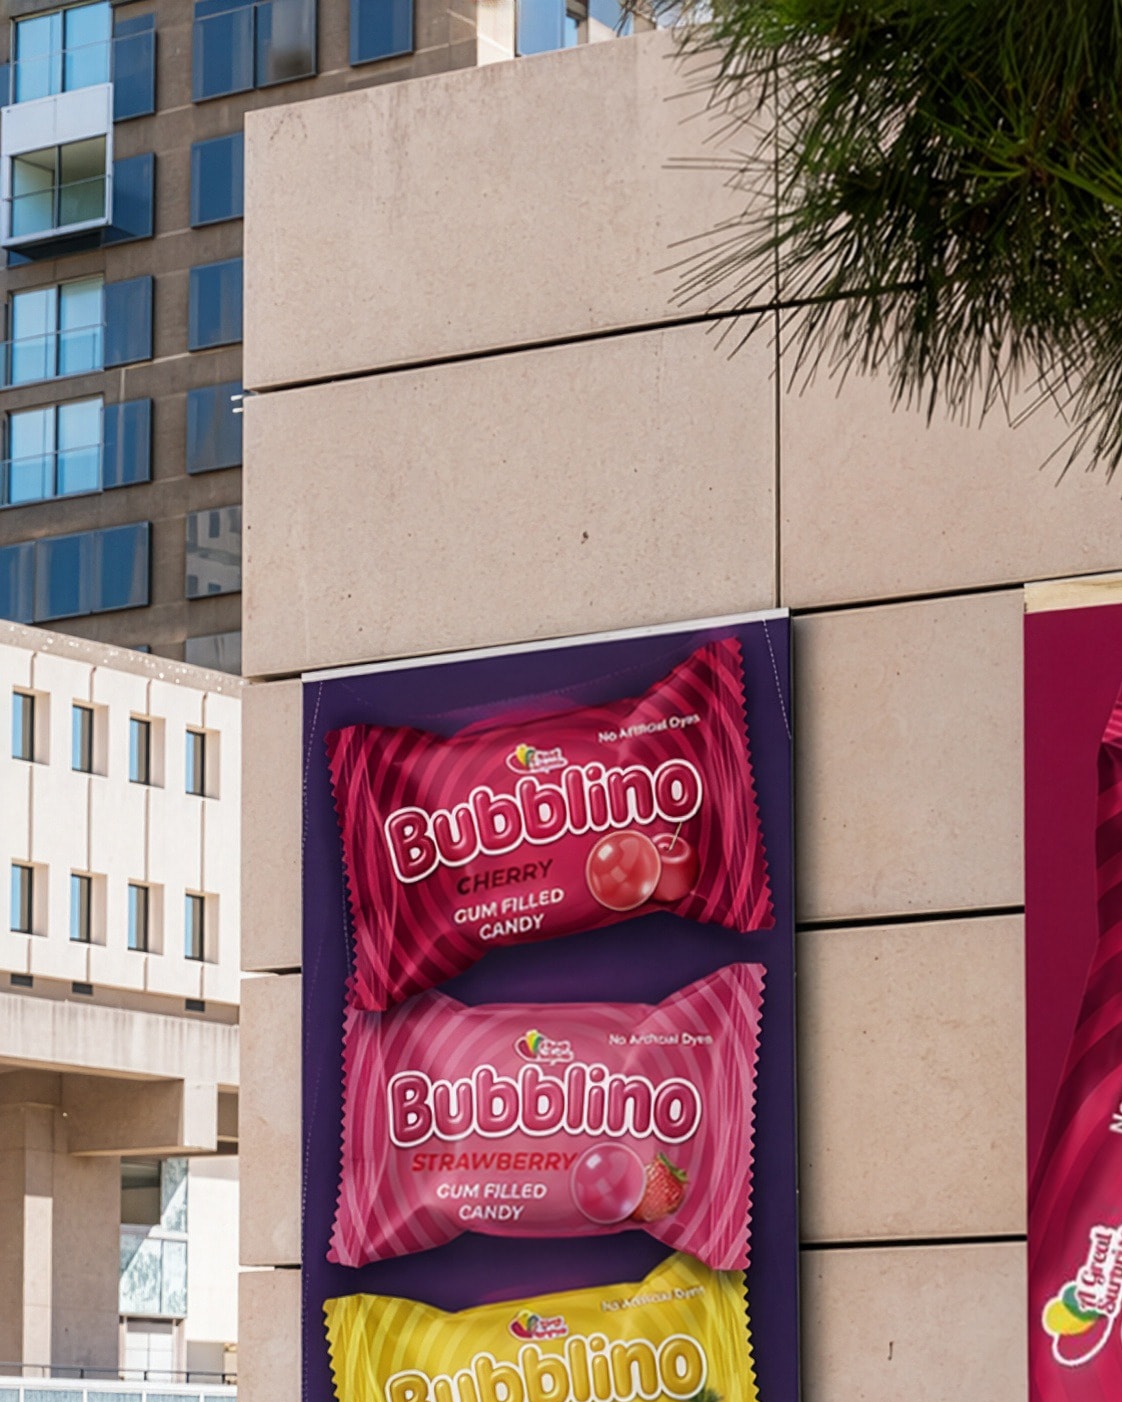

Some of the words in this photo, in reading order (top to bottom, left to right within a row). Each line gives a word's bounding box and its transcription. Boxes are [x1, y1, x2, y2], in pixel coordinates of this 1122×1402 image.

[385, 758, 703, 884] Bubblino
[456, 859, 553, 896] CHERRY
[453, 900, 498, 925] GUM
[500, 887, 565, 917] FILLED
[479, 913, 545, 941] CANDY
[388, 1062, 702, 1148] Bubblino
[411, 1151, 579, 1173] STRAWBERRY
[436, 1183, 482, 1200] GUM
[483, 1183, 548, 1200] FILLED
[458, 1204, 525, 1222] CANDY
